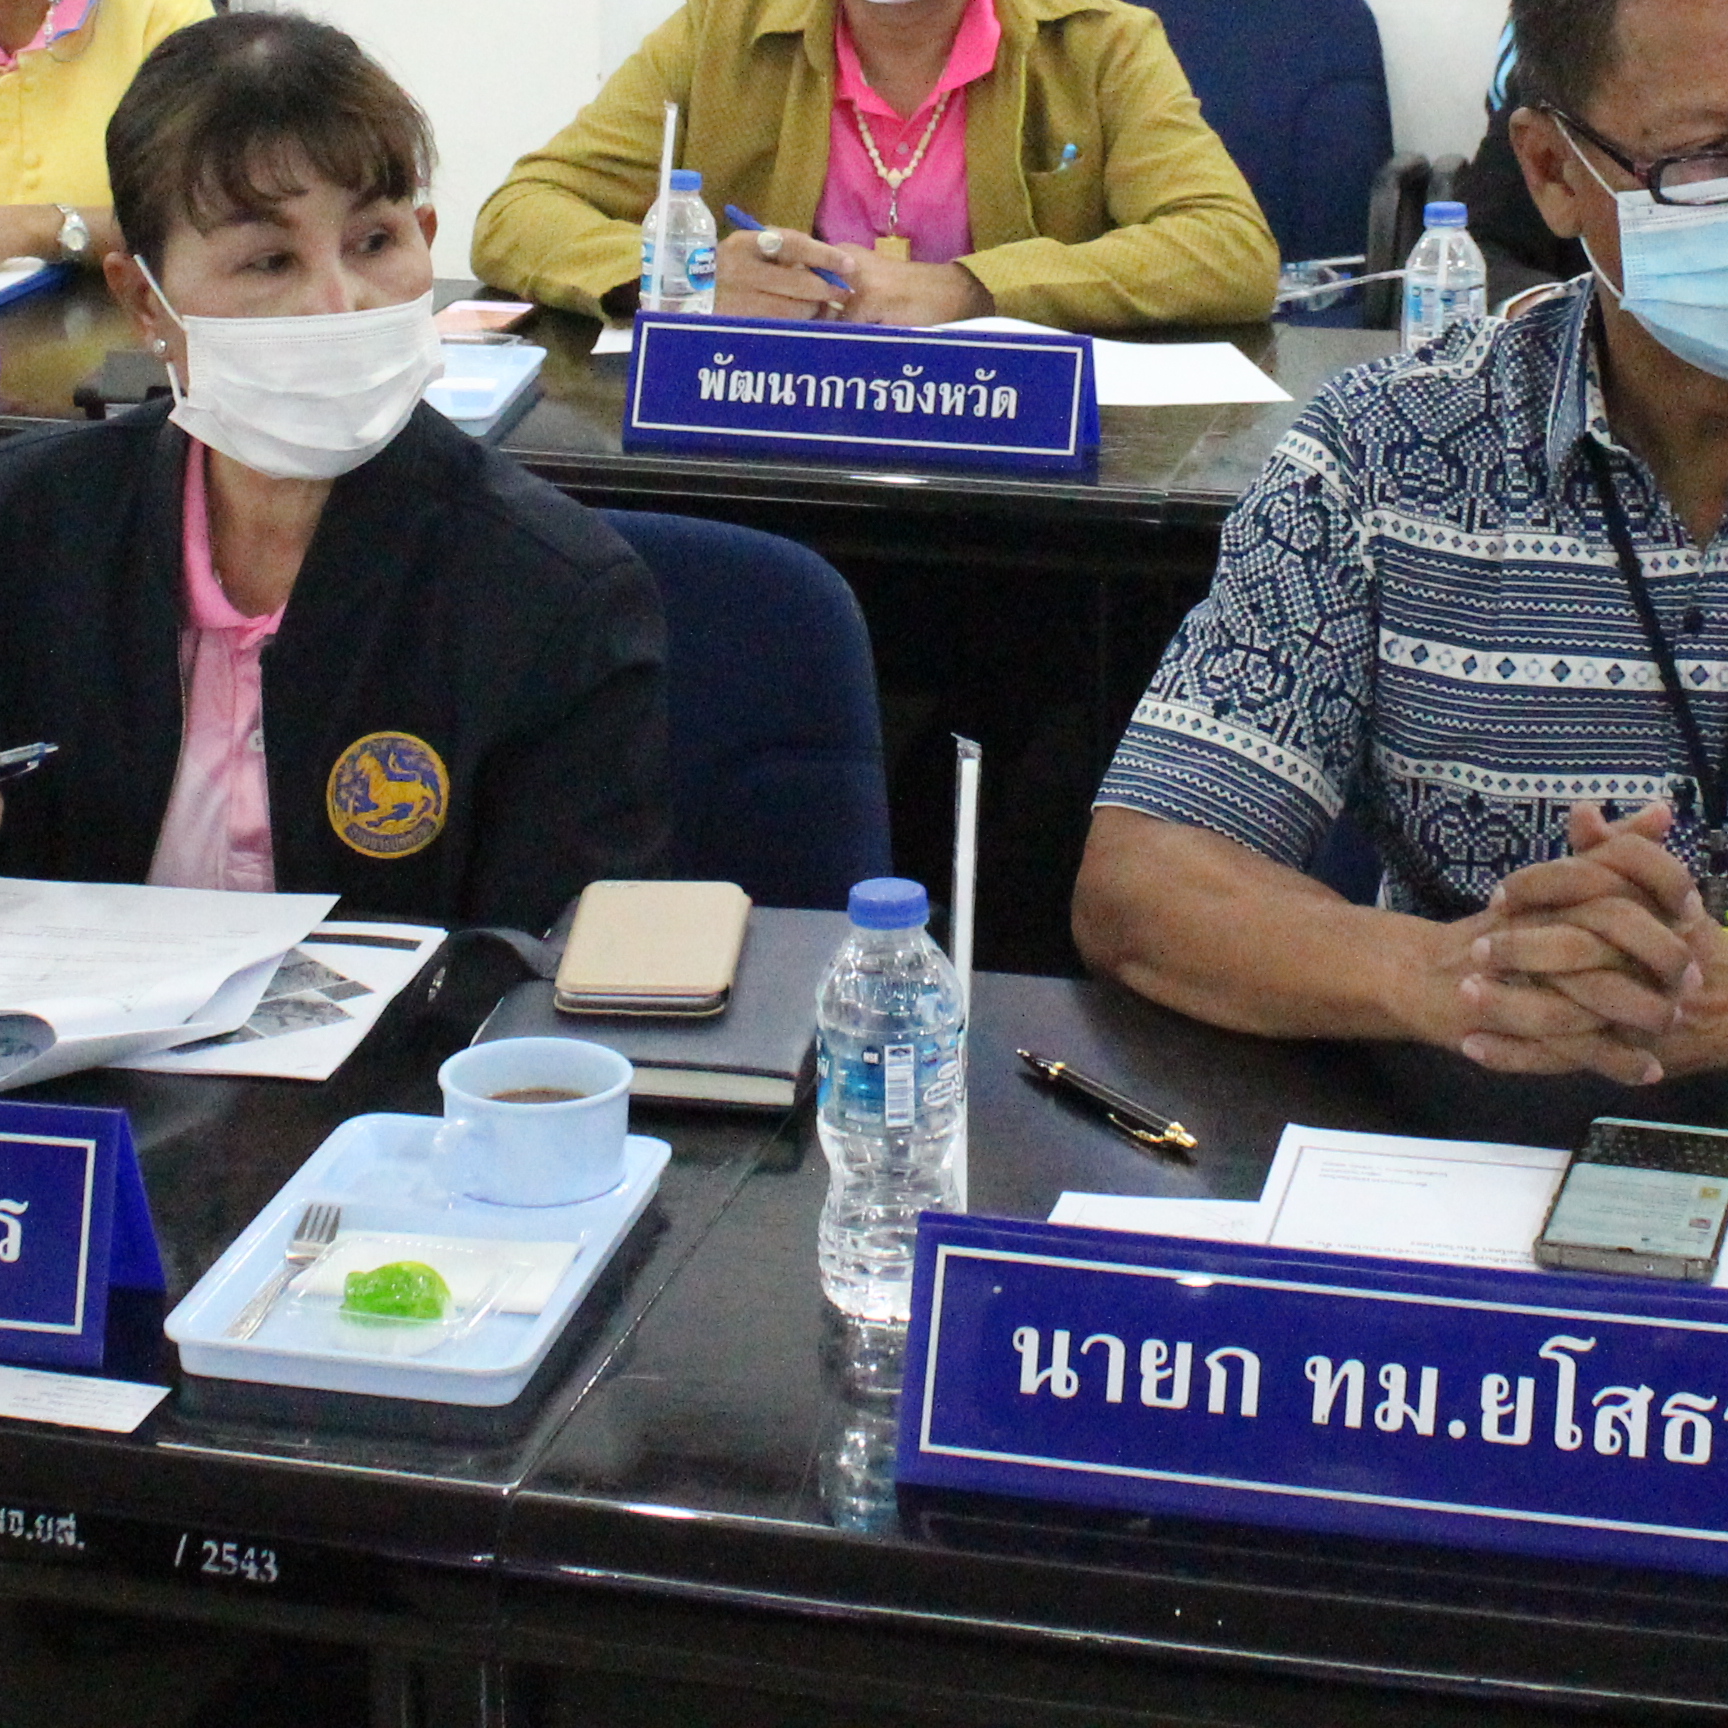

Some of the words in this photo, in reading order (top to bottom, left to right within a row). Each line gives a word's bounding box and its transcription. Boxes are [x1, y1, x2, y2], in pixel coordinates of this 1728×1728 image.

[697, 352, 1019, 421] พัฒนาการจังหวัด
[1013, 1324, 1261, 1419] นายก
[200, 1540, 279, 1583] 2543
